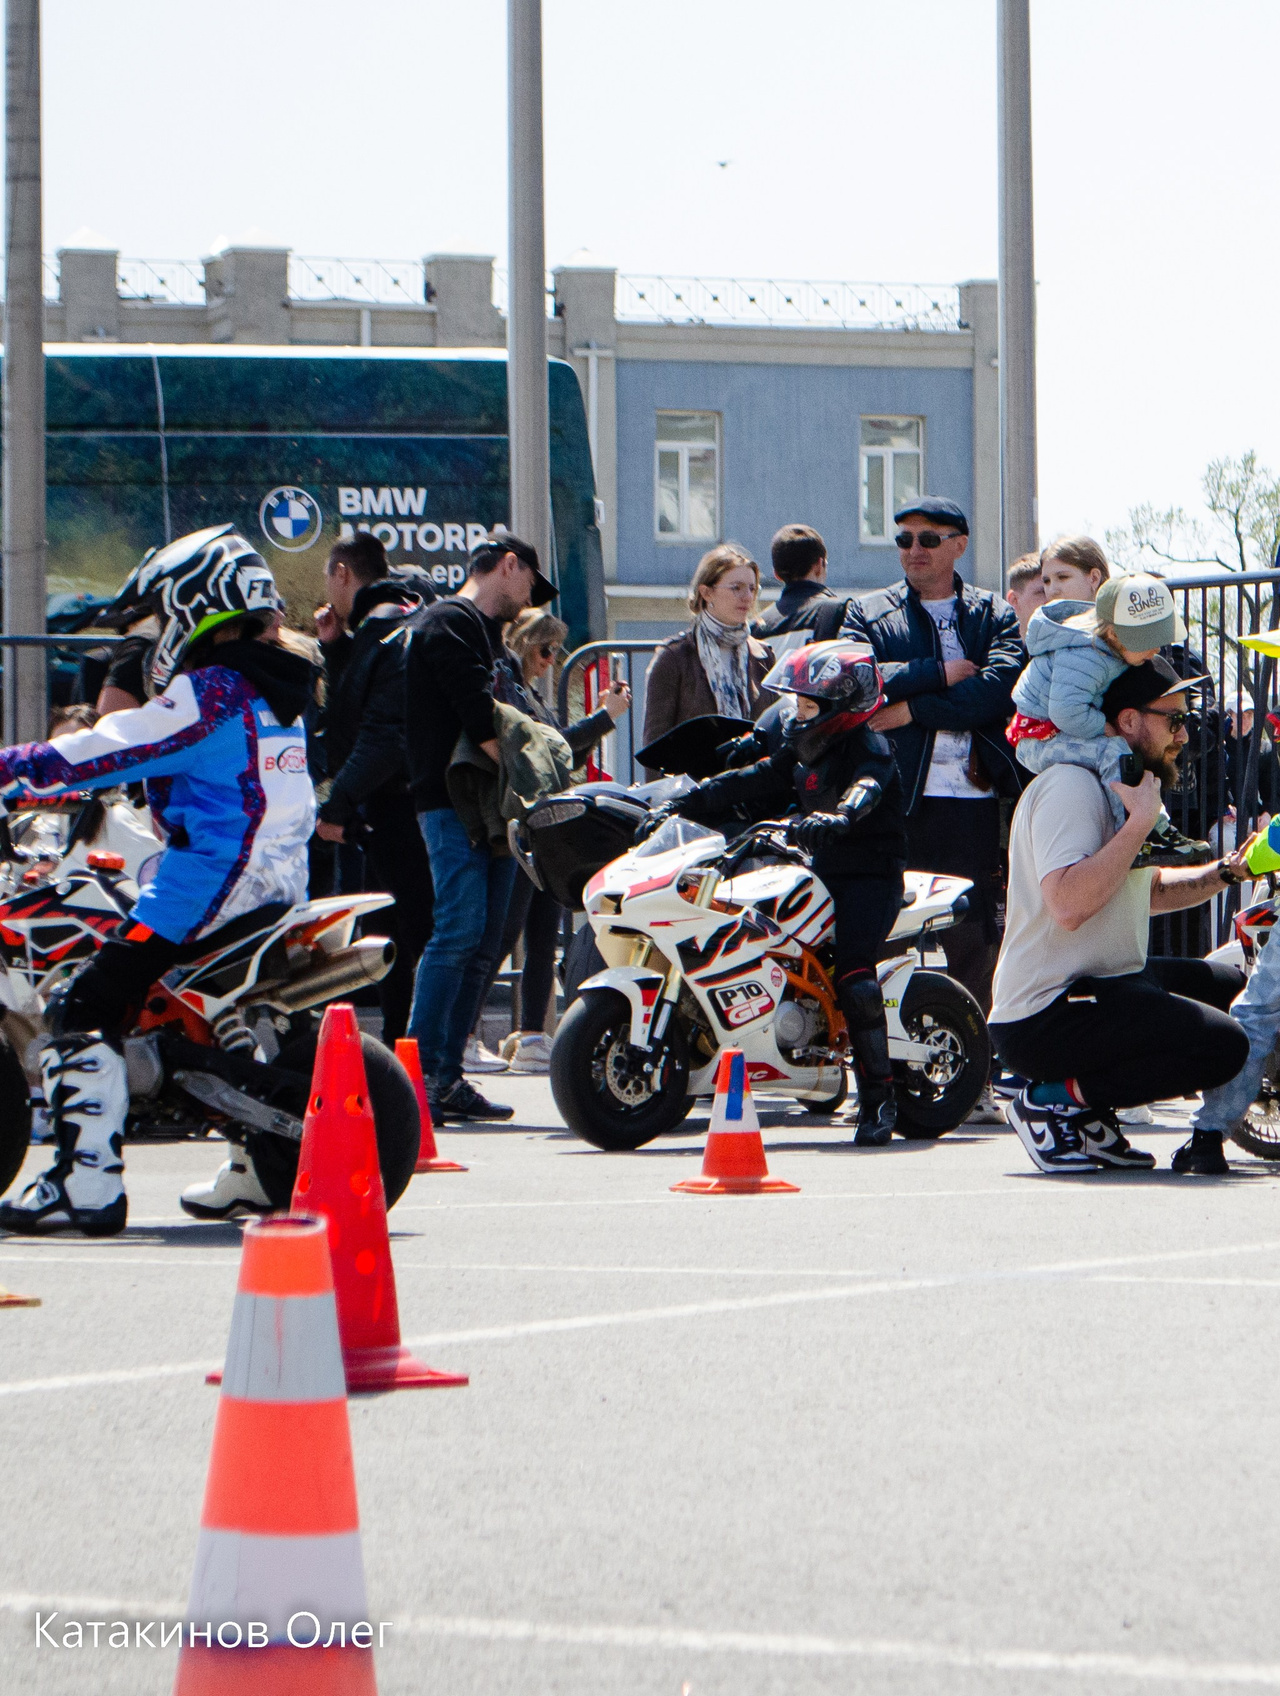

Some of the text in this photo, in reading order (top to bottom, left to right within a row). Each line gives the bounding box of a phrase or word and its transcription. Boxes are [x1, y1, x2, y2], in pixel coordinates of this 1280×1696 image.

[337, 486, 427, 516] BMW
[1127, 596, 1164, 616] SUNSET
[718, 983, 763, 1009] P10
[728, 996, 772, 1025] GP
